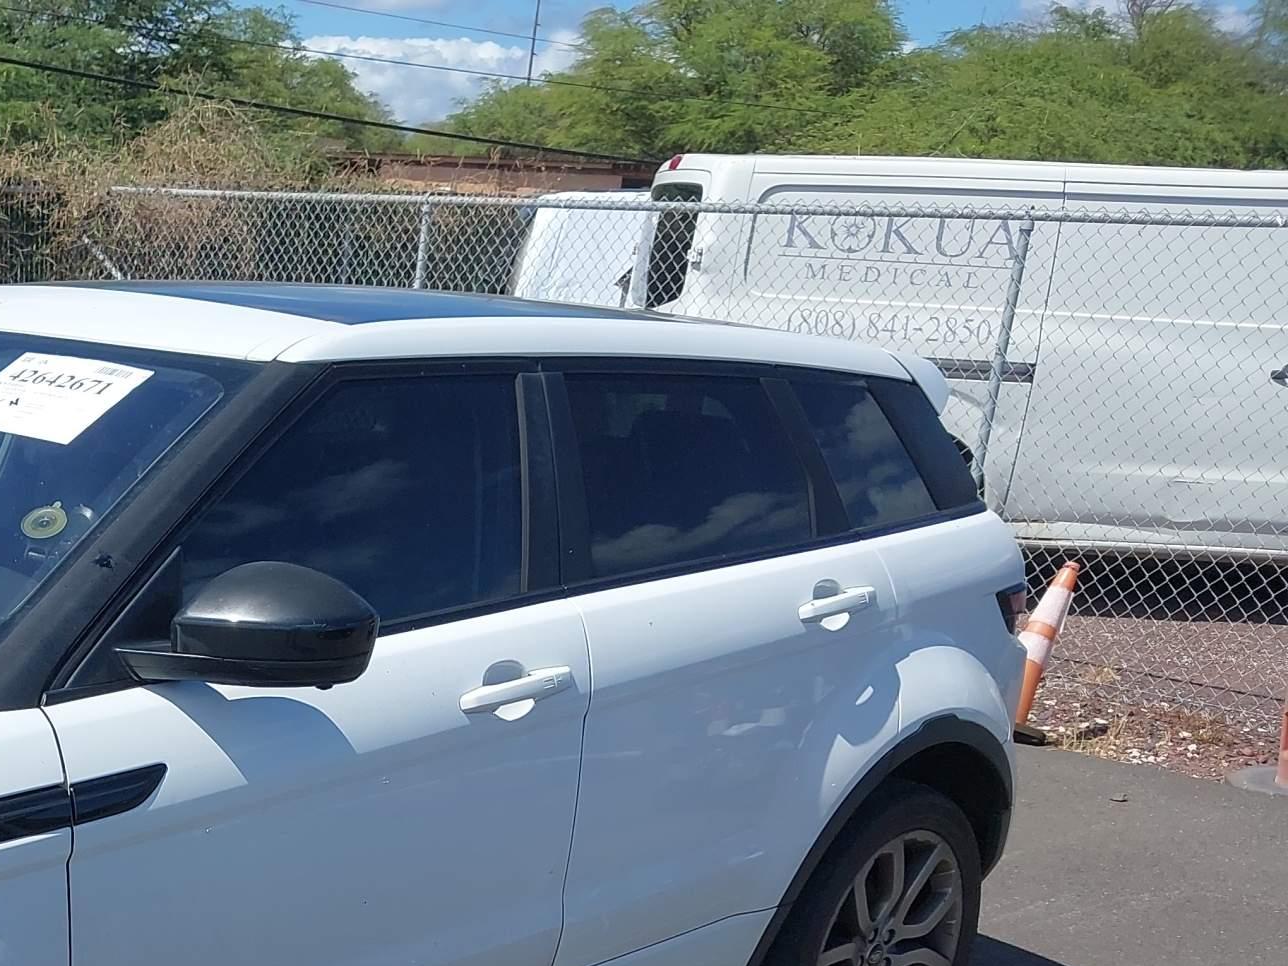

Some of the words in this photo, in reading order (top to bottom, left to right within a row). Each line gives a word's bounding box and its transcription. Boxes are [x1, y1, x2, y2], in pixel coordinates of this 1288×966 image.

[783, 211, 1020, 260] KOKUA
[805, 262, 980, 289] MEDICAL
[786, 308, 856, 341] (808)
[866, 312, 992, 346] 841-2850
[9, 368, 114, 395] 42642671
